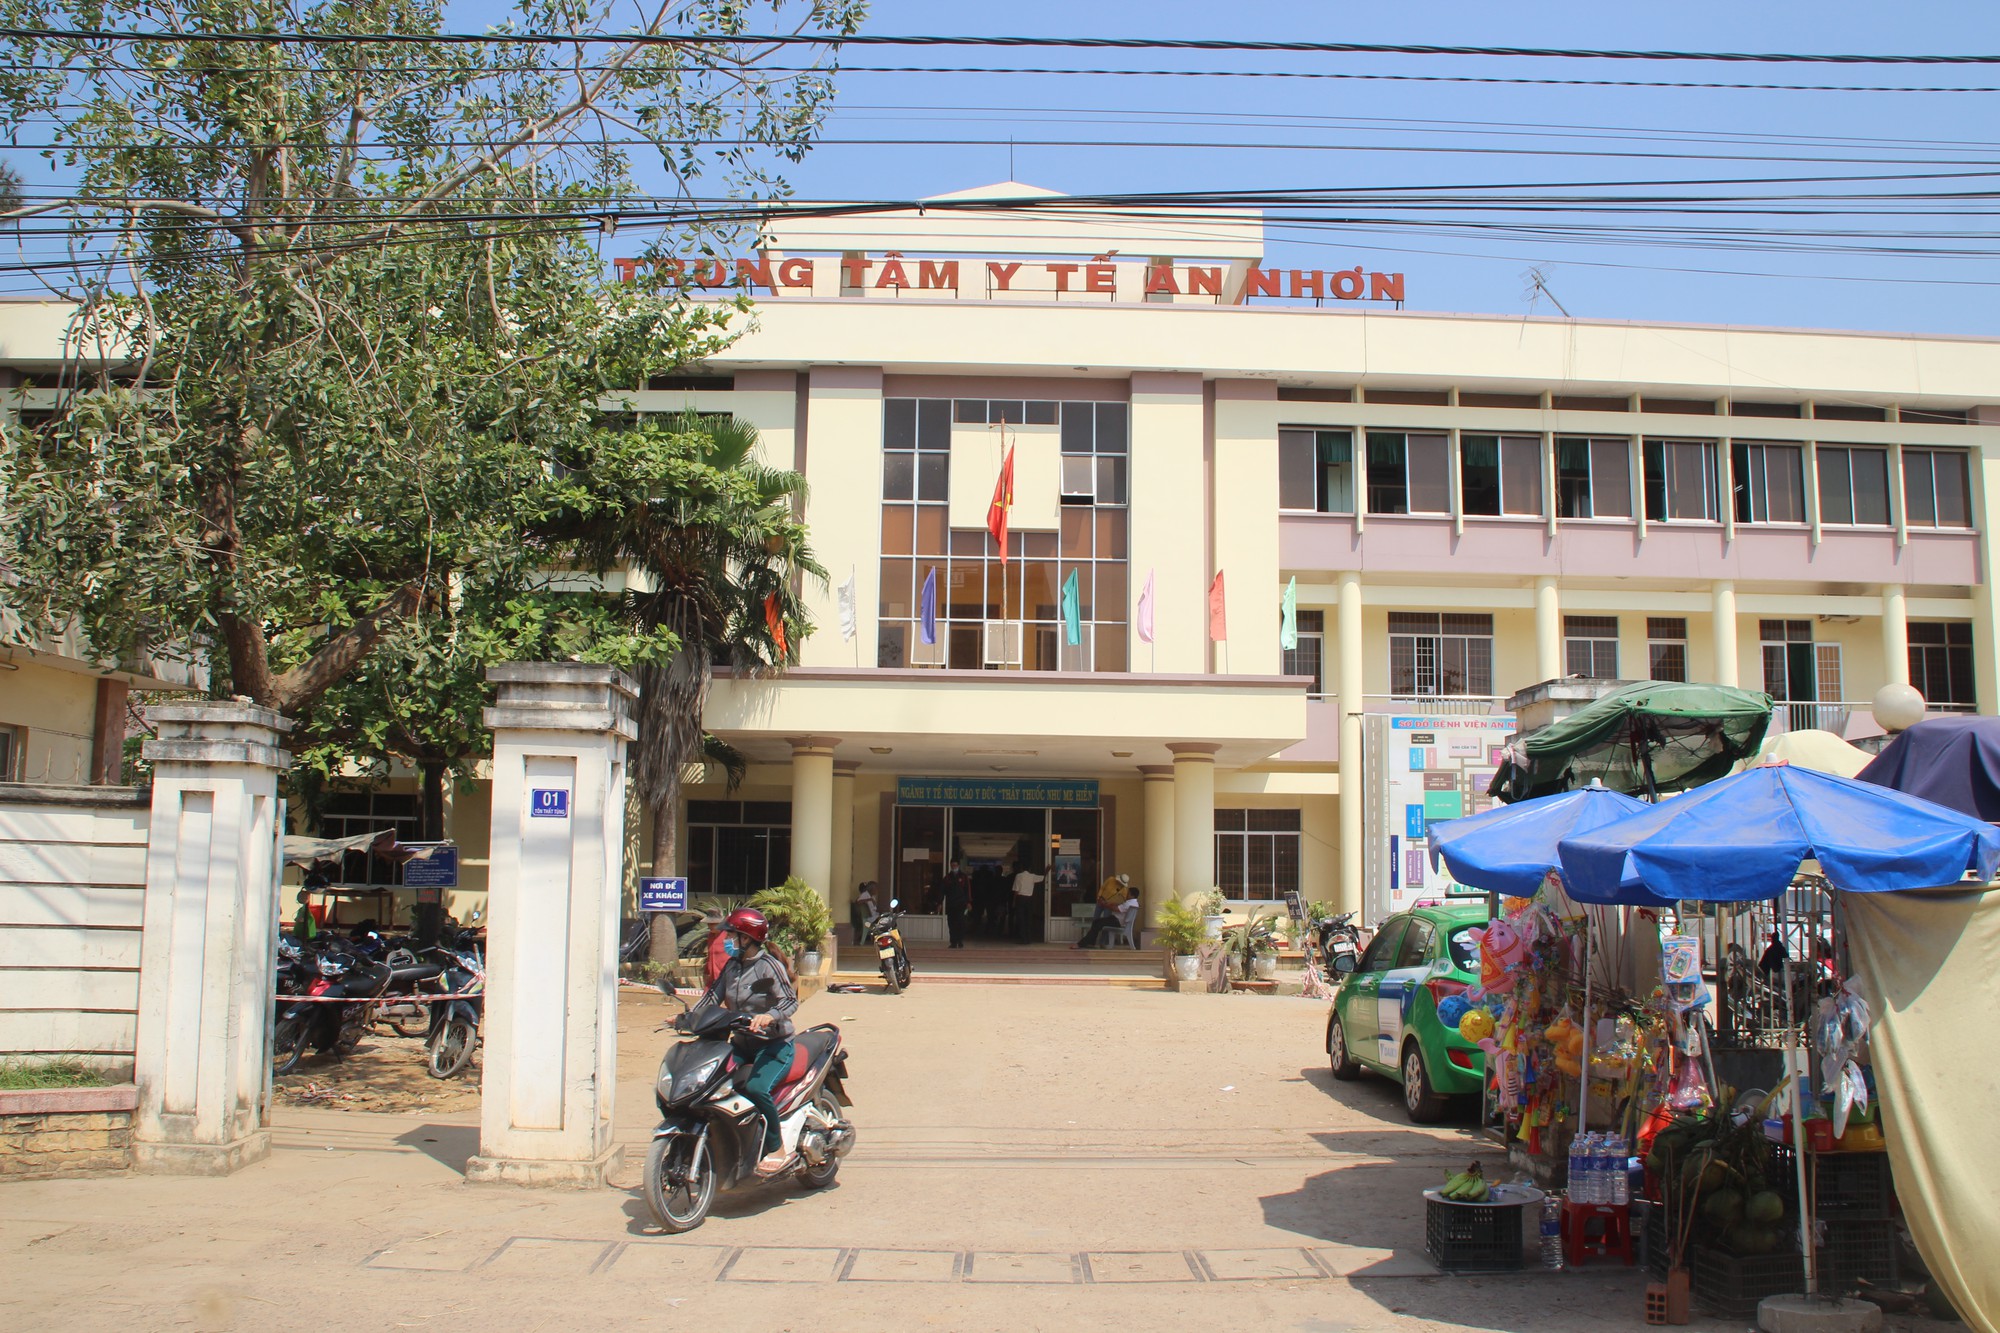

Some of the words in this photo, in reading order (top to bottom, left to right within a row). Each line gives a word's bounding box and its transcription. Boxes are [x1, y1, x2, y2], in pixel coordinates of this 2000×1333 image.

[613, 257, 813, 287] TRUNG
[841, 250, 959, 289] TÂM
[985, 262, 1022, 290] Y
[1047, 250, 1119, 292] TẾ
[1146, 265, 1222, 295] AN
[1246, 265, 1404, 300] NHƠN
[1399, 719, 1413, 728] SƠ
[1433, 719, 1460, 729] BỆNH
[1464, 719, 1488, 730] VIỆN
[901, 784, 925, 798] NGÀNH
[927, 787, 931, 798] Y
[933, 783, 944, 799] TẾ
[944, 785, 958, 799] NÊU
[960, 788, 973, 800] CAO
[975, 788, 980, 800] Y
[982, 785, 996, 800] ĐỨC
[1022, 784, 1045, 800] THUỐC
[1047, 787, 1062, 800] NHƯ
[543, 791, 558, 806] 01
[650, 881, 663, 889] NƠI
[665, 880, 677, 890] ĐỂ
[655, 890, 683, 899] KHÁCH
